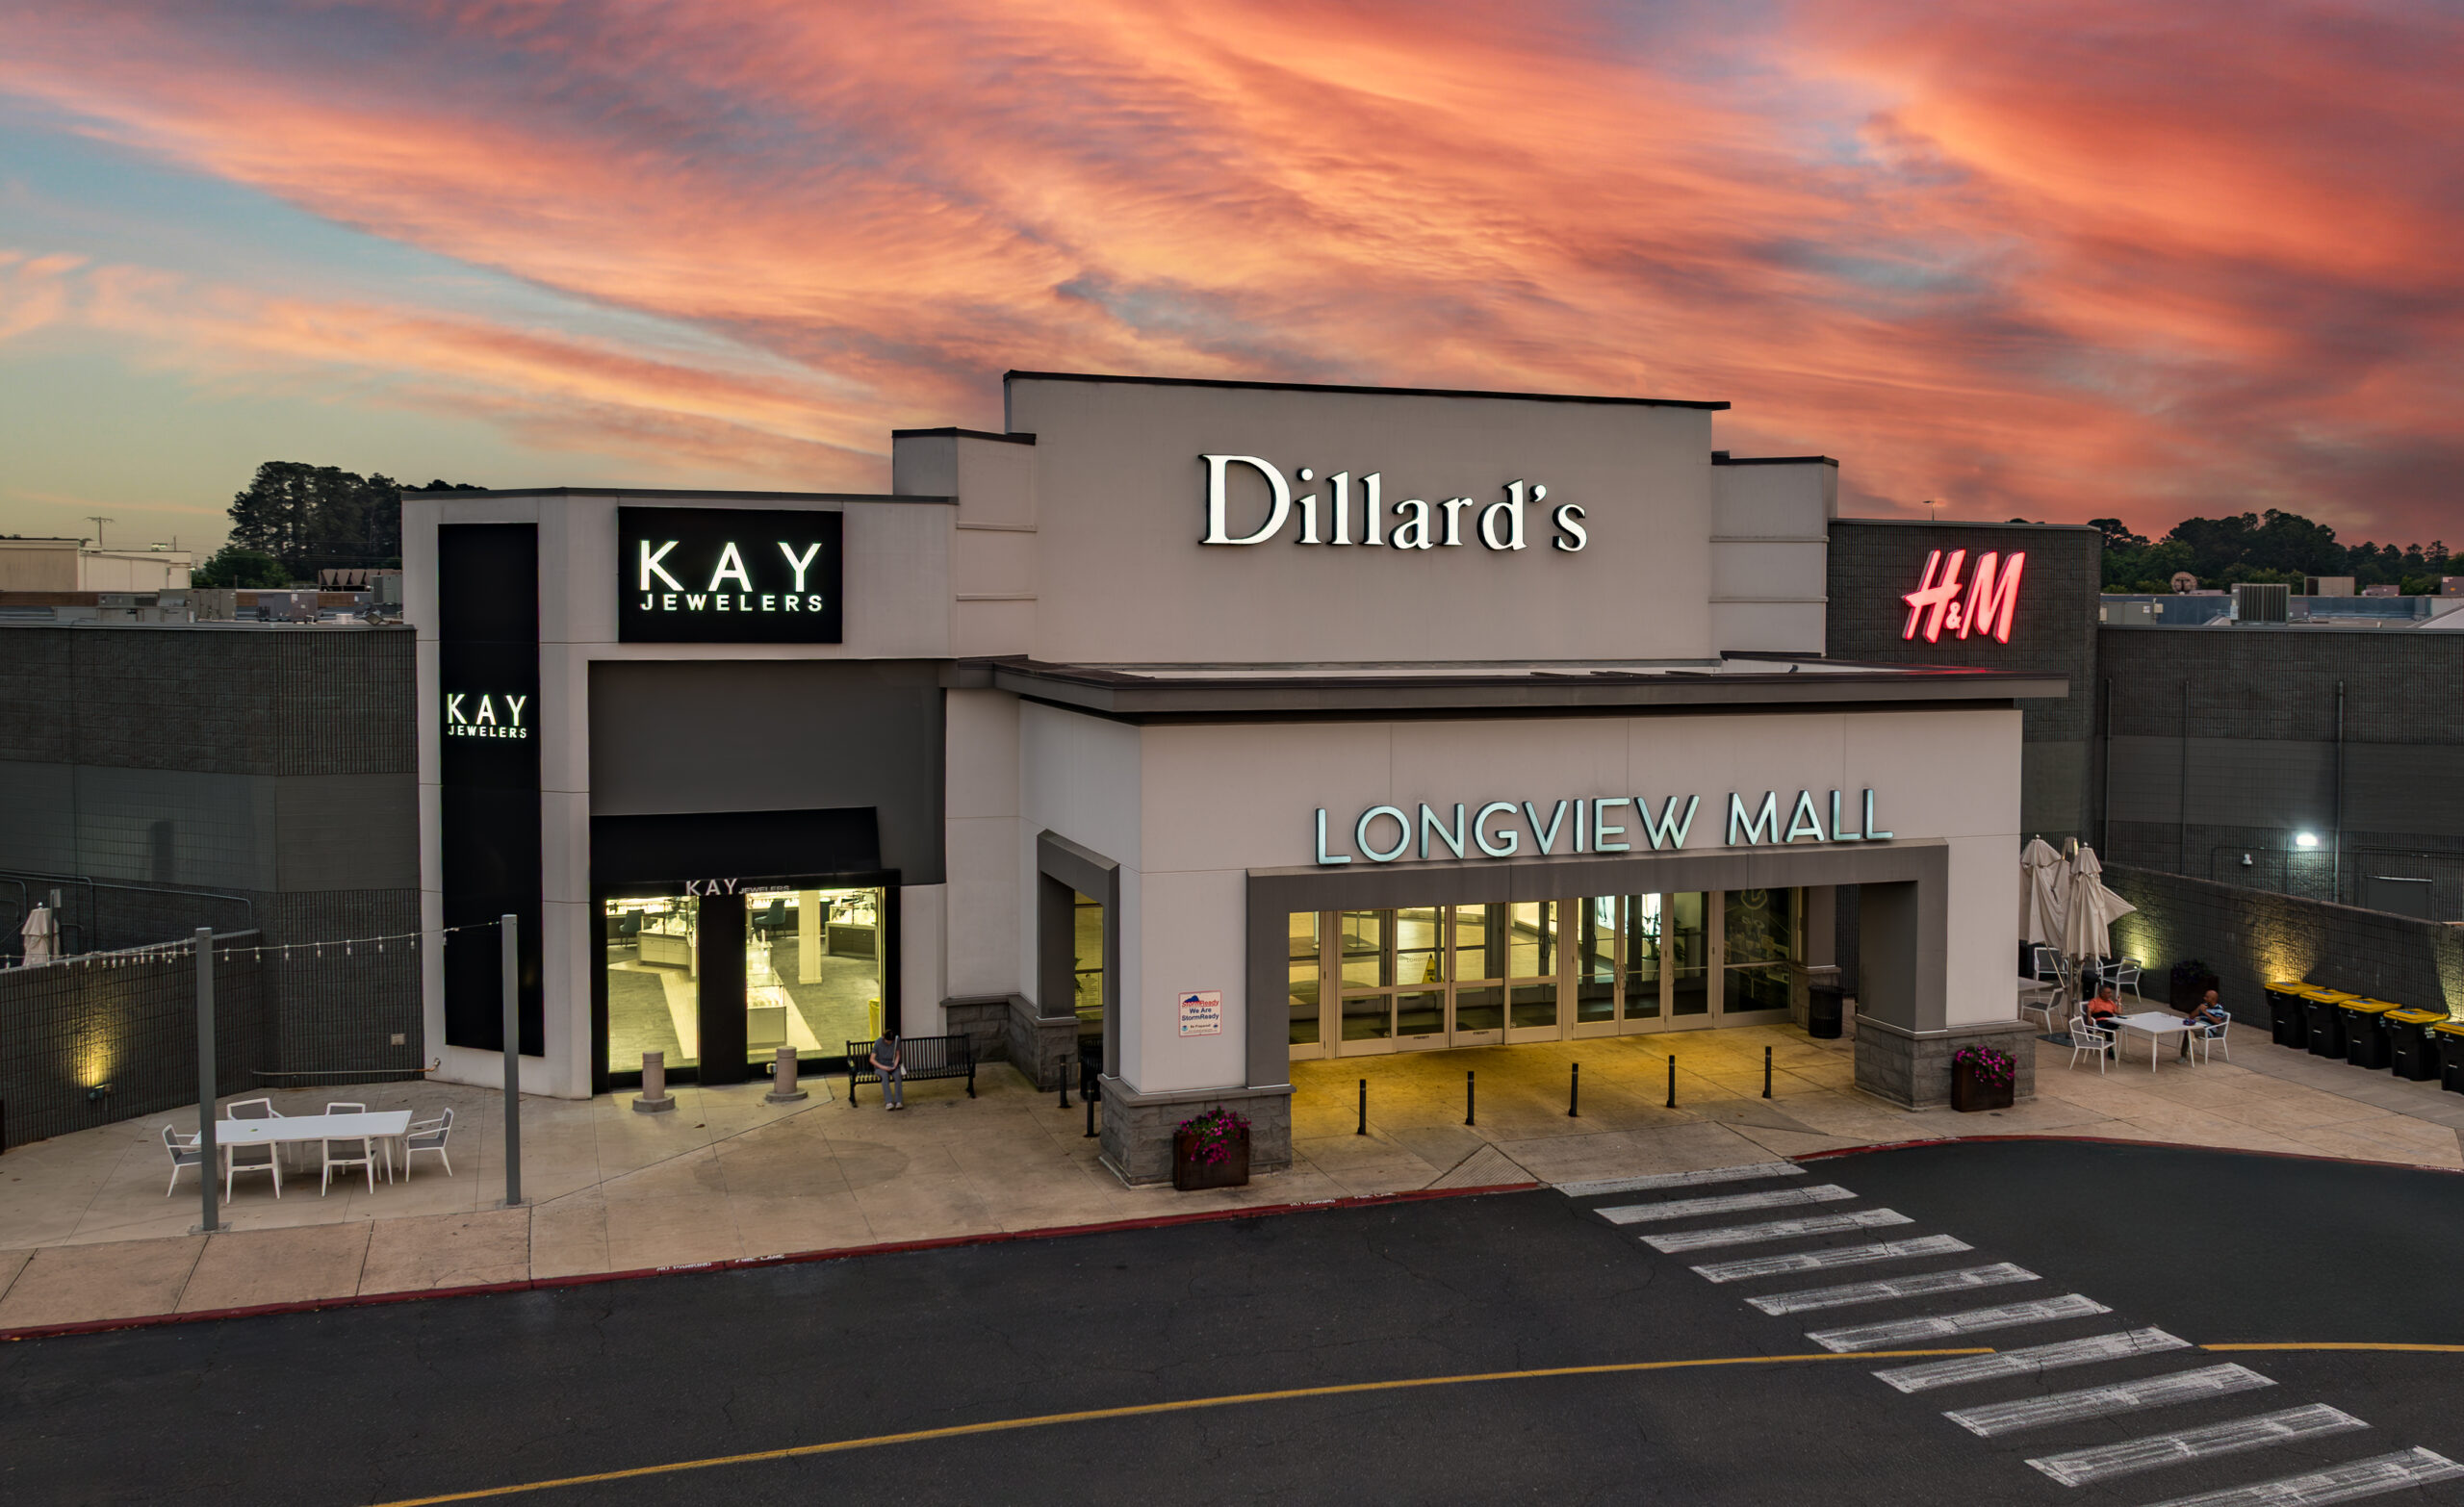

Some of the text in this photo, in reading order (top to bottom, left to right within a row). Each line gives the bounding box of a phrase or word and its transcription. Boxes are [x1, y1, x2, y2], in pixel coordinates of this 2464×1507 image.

[1198, 453, 1588, 552] Dillard's
[640, 540, 822, 592] KAY
[640, 594, 822, 611] JEWELERS
[1902, 549, 2026, 644] H&M
[448, 693, 526, 726] KAY
[448, 726, 526, 738] JEWELERS
[1315, 788, 1894, 864] LONGVIEW MALL
[685, 878, 790, 896] KAY JEWELERS
